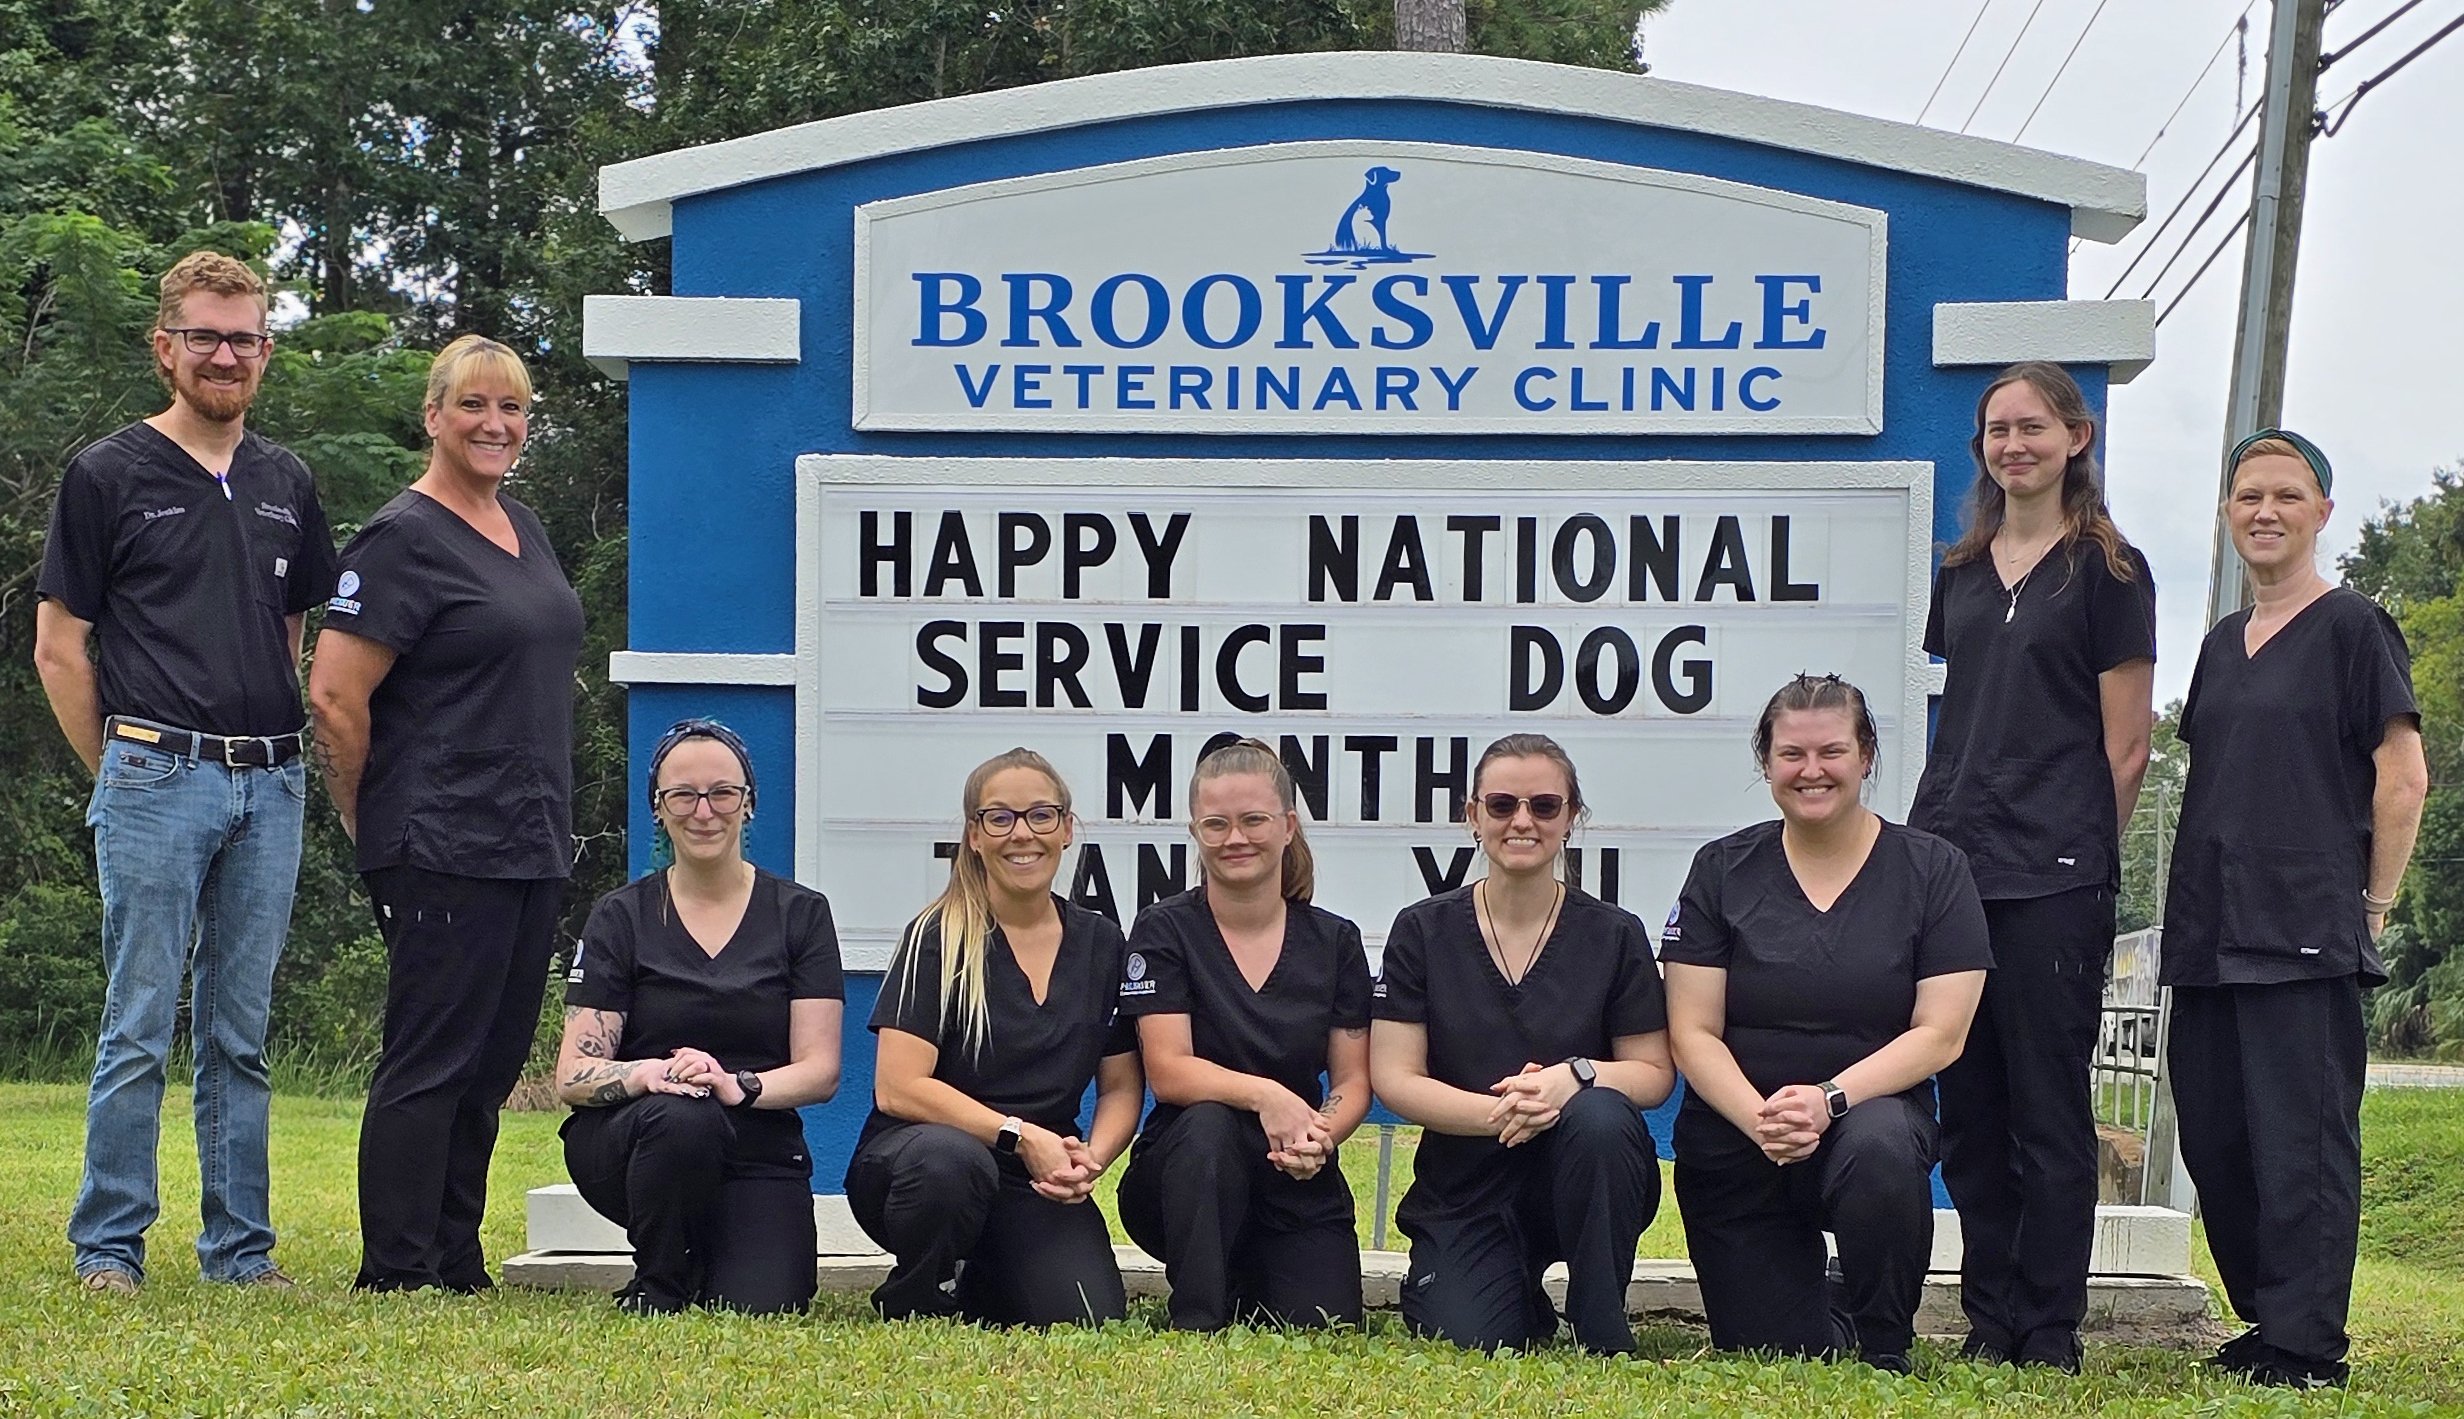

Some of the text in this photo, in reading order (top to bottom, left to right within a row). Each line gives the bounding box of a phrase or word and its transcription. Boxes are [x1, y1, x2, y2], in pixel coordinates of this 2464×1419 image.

[911, 272, 1827, 350] BROOKSVILLE
[954, 363, 1783, 412] VETERINARY CLINIC
[859, 510, 1819, 604] HAPPY NATIONAL
[916, 619, 1713, 715] SERVICE DOG
[1106, 731, 1469, 823] MNTH
